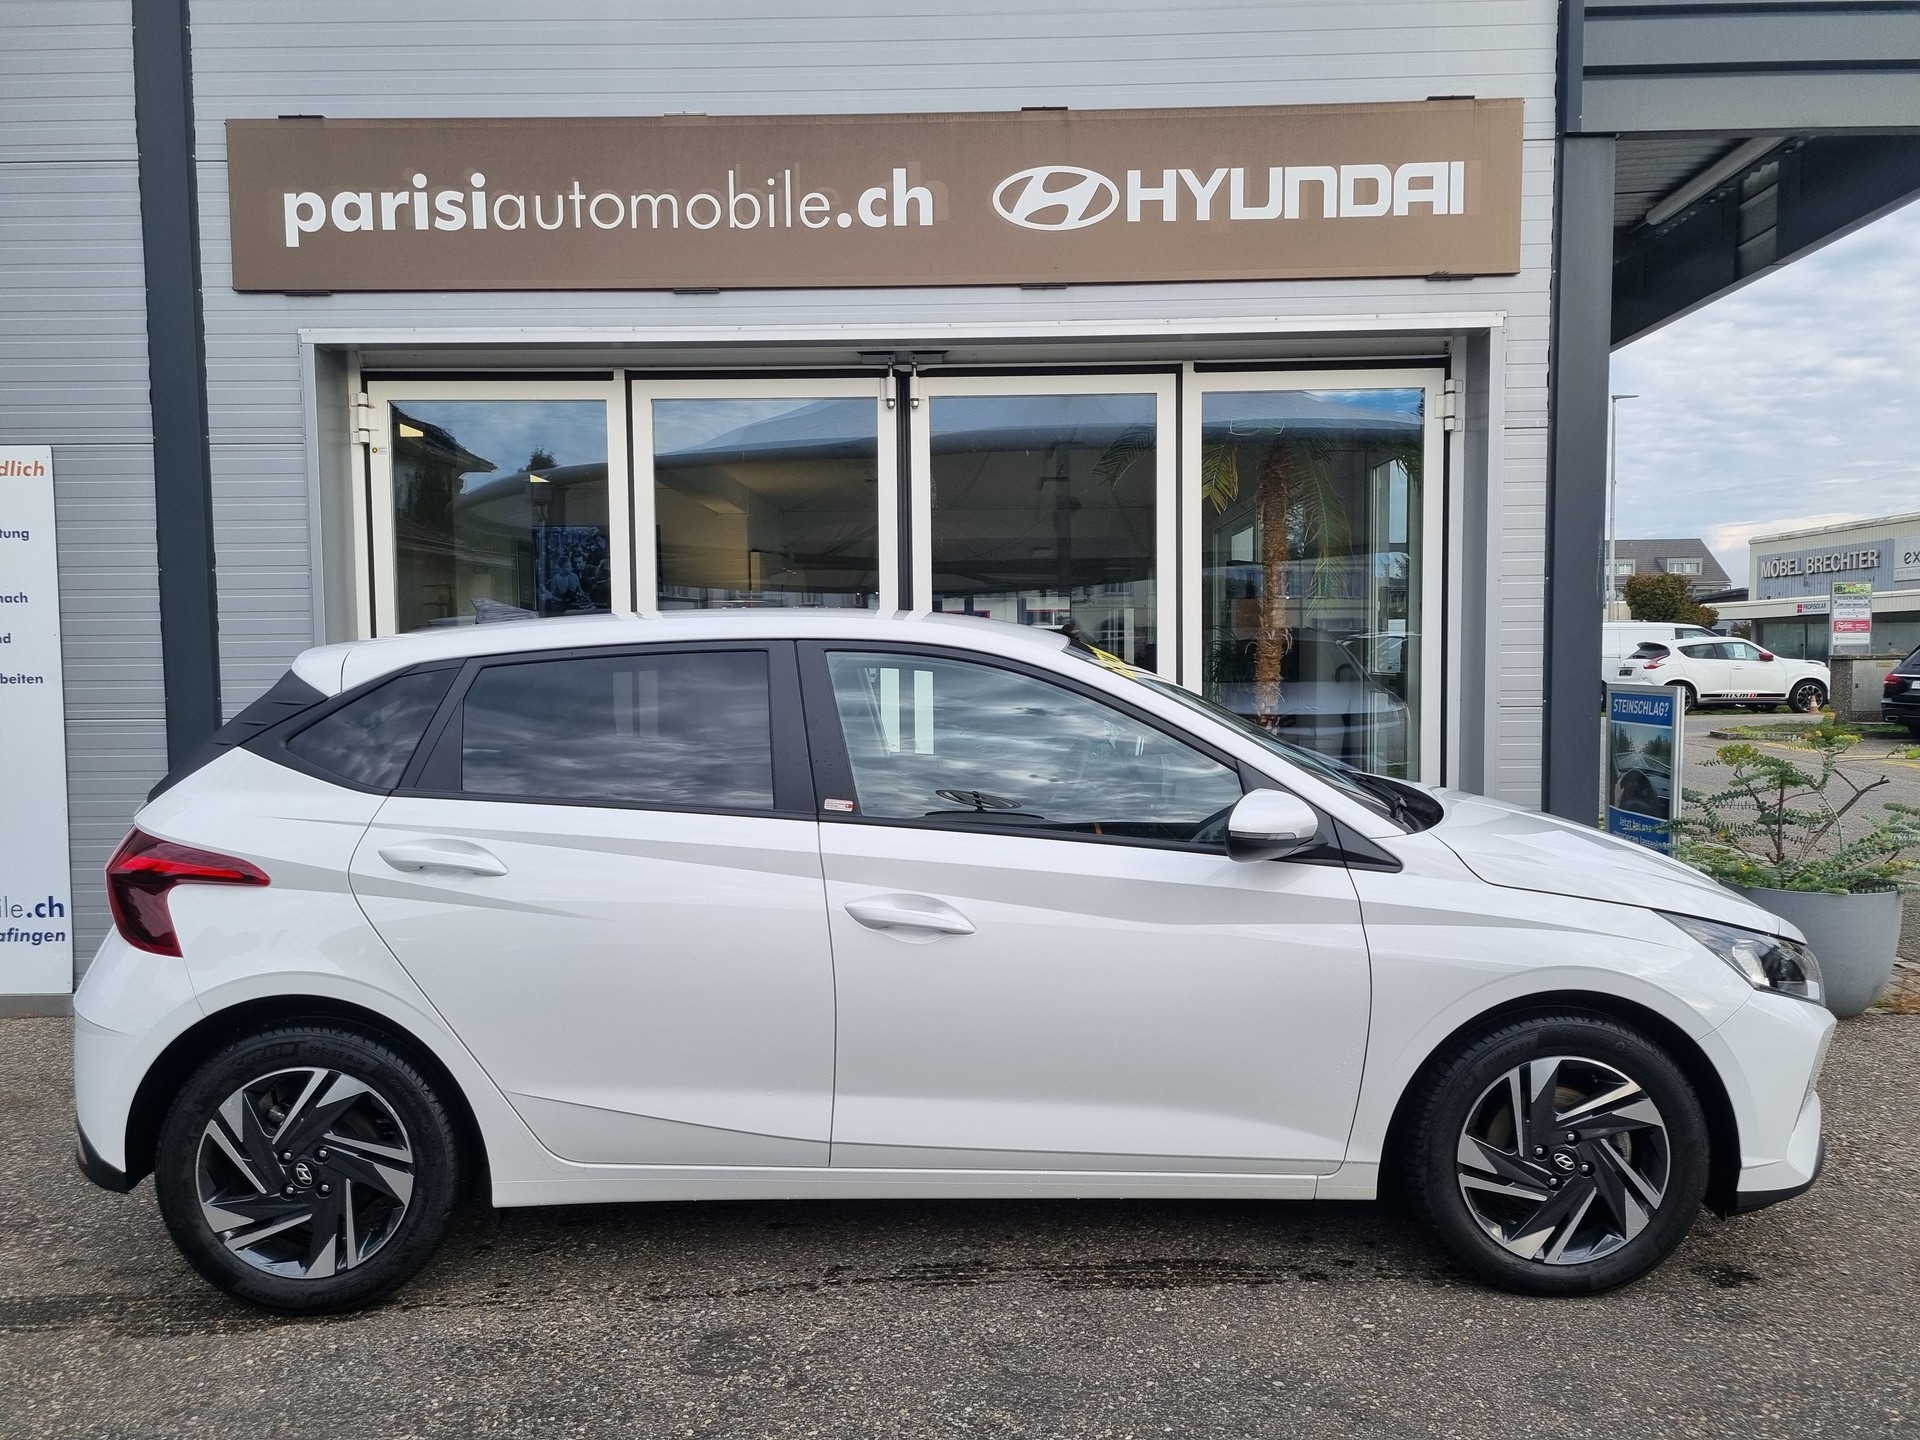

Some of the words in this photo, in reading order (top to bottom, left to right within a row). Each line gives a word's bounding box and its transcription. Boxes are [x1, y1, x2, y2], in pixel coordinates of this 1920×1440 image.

[283, 168, 934, 248] parisiautomobile.ch
[1126, 161, 1465, 222] HYUNDAI
[1761, 556, 1804, 579] MÖBEL
[1805, 549, 1881, 575] BRECHTER
[1613, 698, 1670, 718] STEINSCHLAG?
